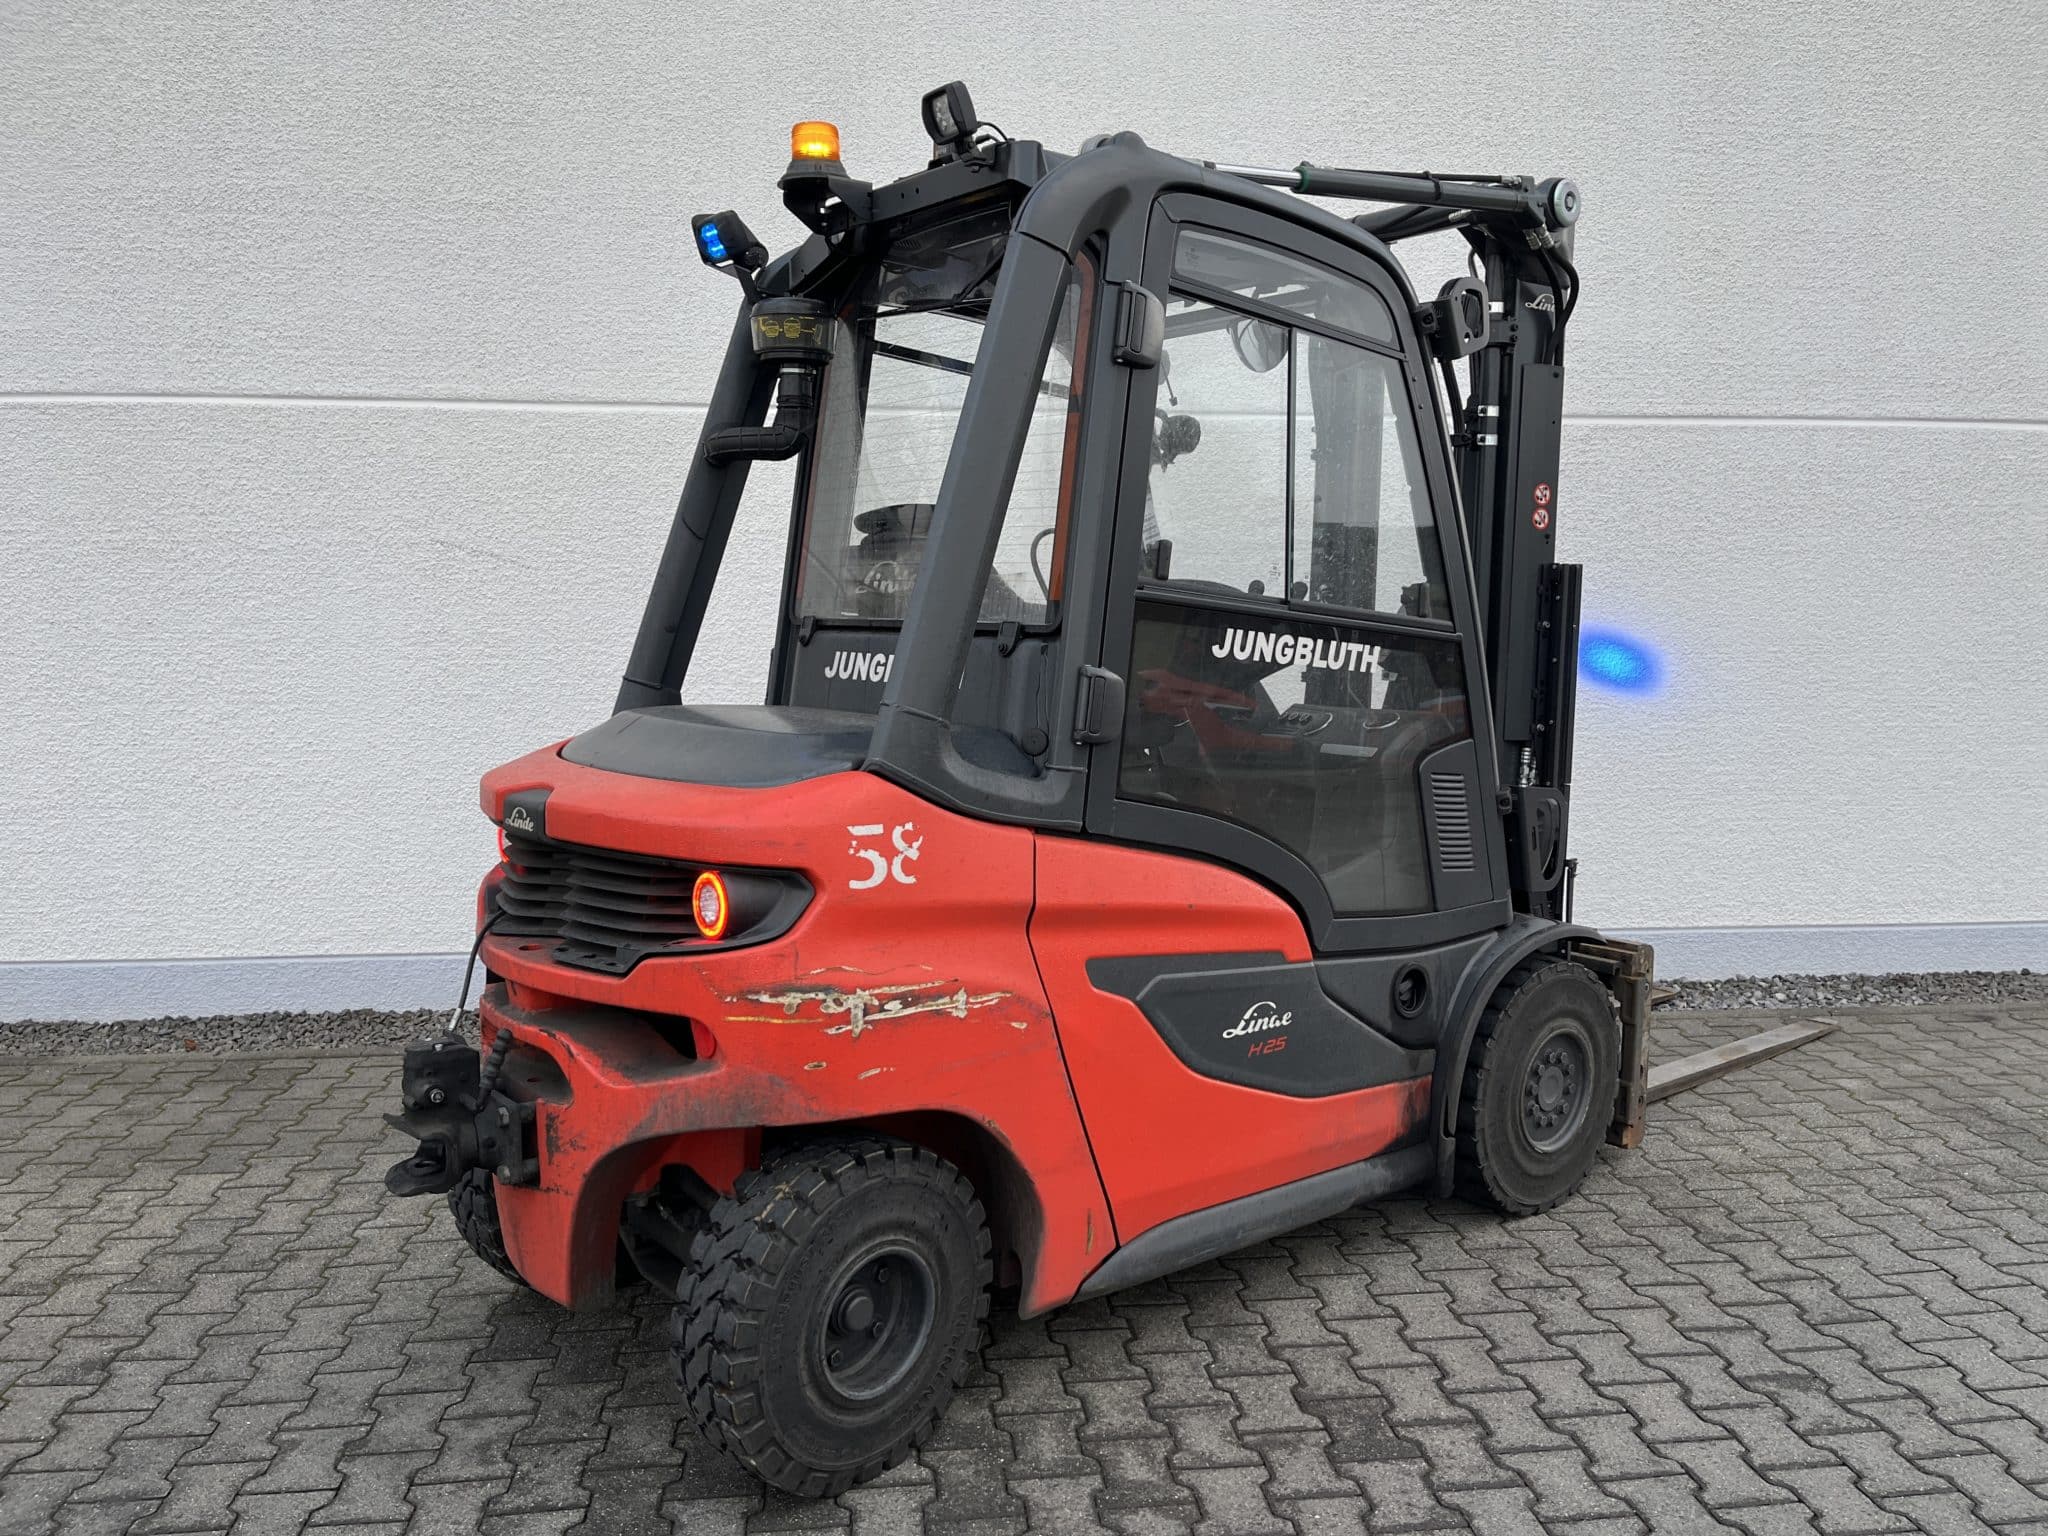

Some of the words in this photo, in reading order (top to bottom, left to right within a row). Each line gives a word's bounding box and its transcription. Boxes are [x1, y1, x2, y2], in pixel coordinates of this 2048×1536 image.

[1211, 628, 1381, 674] JUNGBLUTH
[505, 807, 534, 831] Linde
[847, 822, 923, 889] 58
